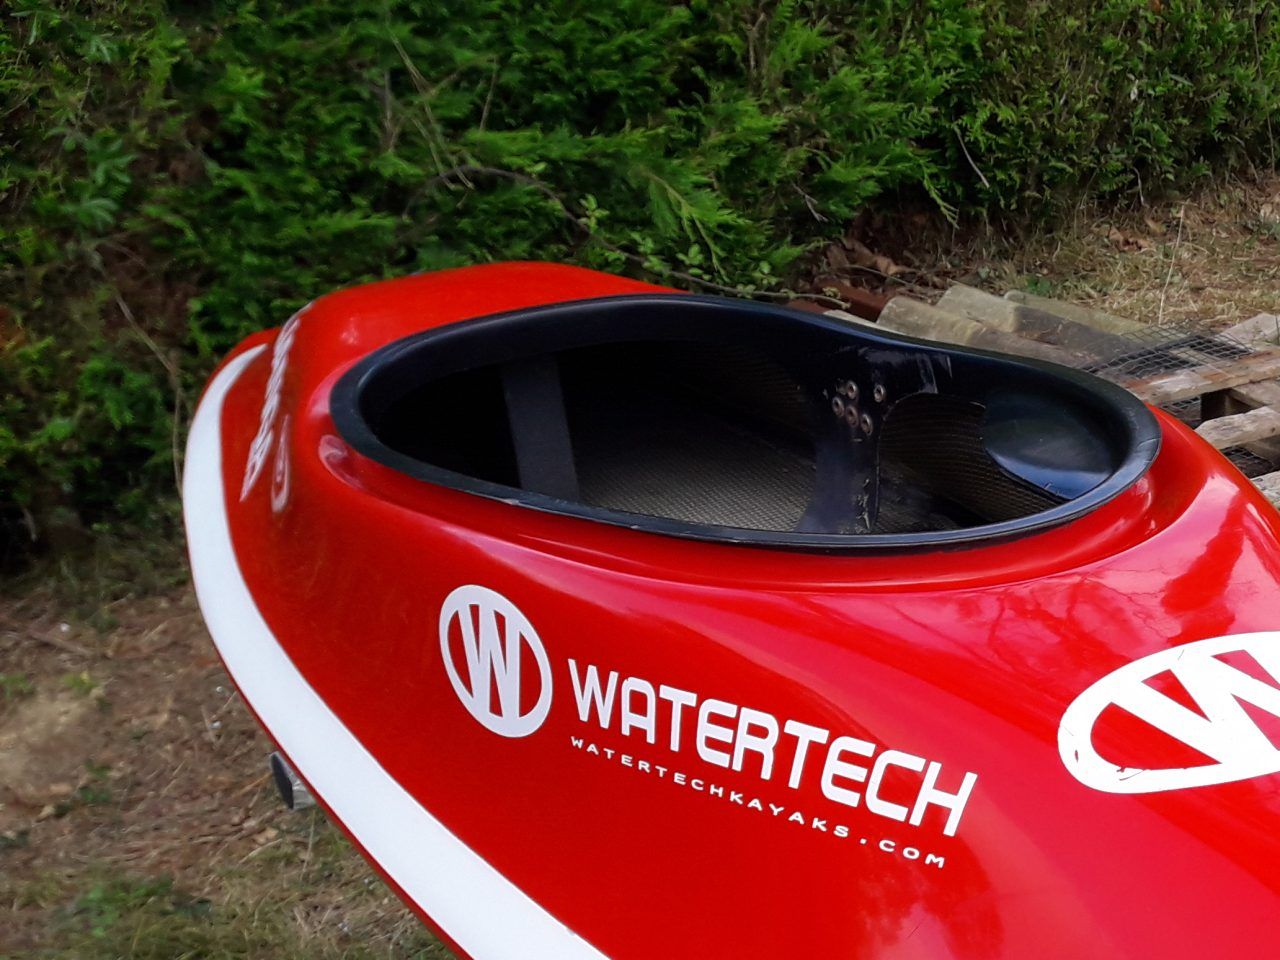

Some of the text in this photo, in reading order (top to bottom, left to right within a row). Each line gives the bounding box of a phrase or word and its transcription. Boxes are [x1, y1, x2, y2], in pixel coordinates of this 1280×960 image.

[448, 592, 532, 730] W
[568, 658, 978, 838] WATERTECH
[570, 735, 946, 869] WATERTECHKAYAKS.COM
